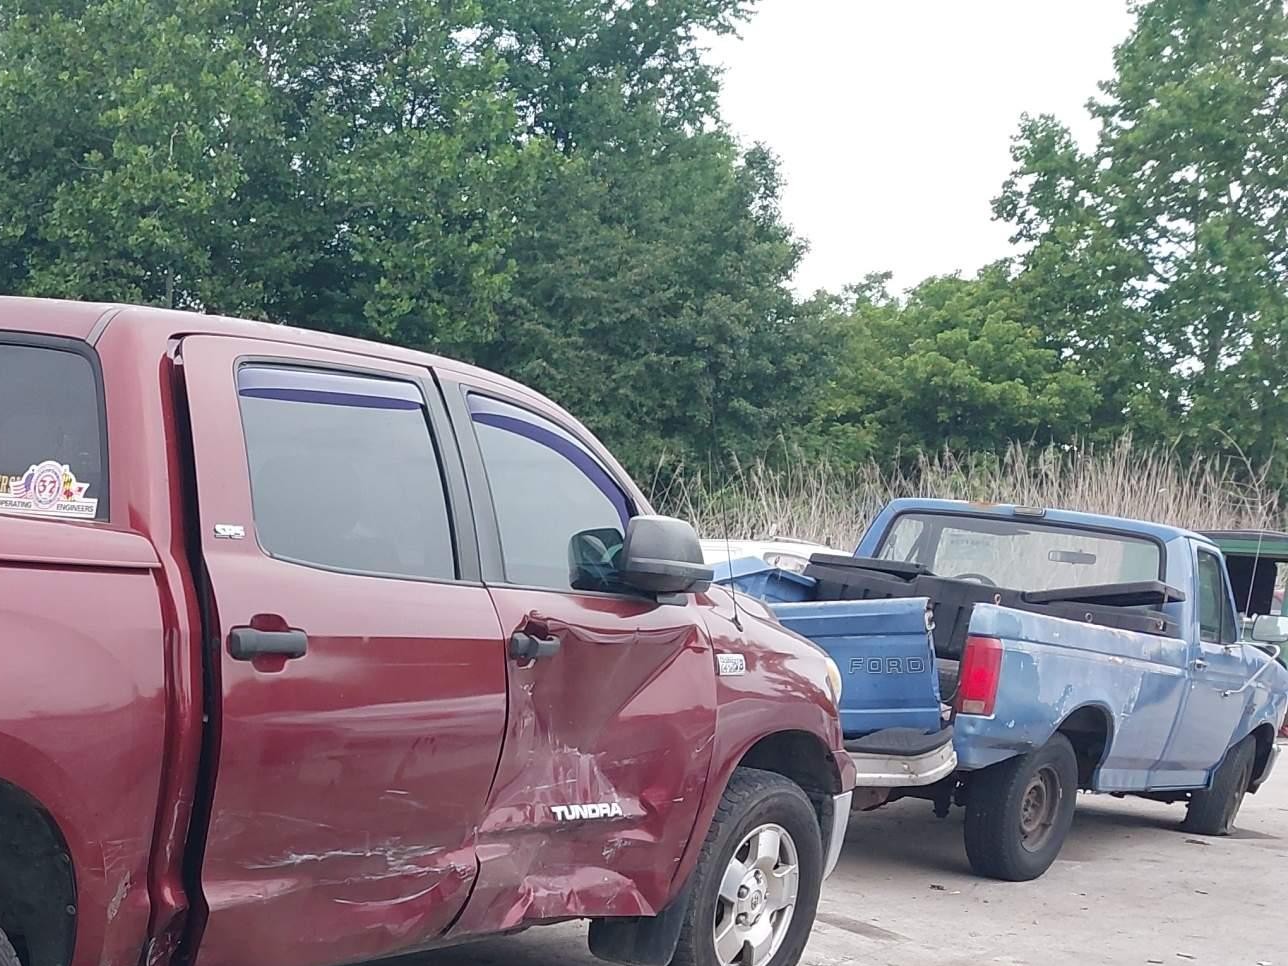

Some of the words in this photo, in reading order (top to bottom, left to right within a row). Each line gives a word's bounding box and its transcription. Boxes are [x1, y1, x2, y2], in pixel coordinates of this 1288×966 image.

[56, 502, 95, 513] ENGINEERS
[847, 657, 925, 674] FORD
[550, 802, 624, 821] TUNDRA
